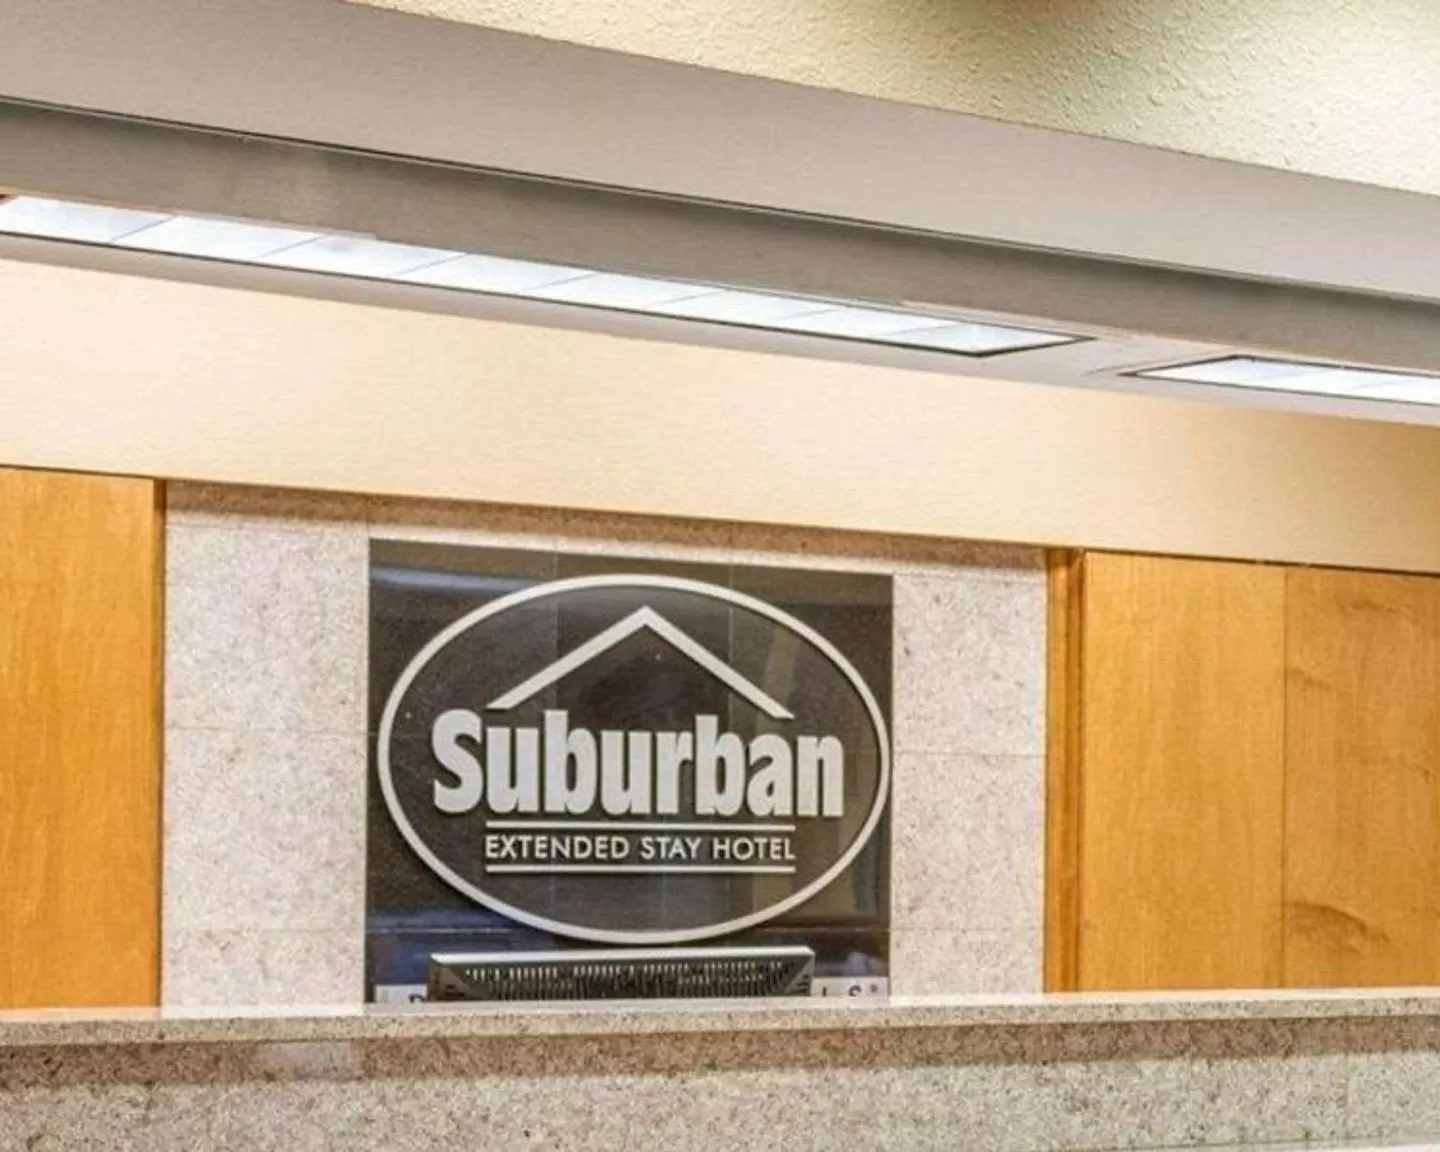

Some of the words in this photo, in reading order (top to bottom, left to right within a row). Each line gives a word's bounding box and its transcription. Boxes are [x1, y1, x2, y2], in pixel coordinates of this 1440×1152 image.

[432, 708, 843, 816] Suburban
[485, 835, 630, 859] EXTENDED
[640, 836, 701, 860] STAY
[713, 837, 796, 860] HOTEL
